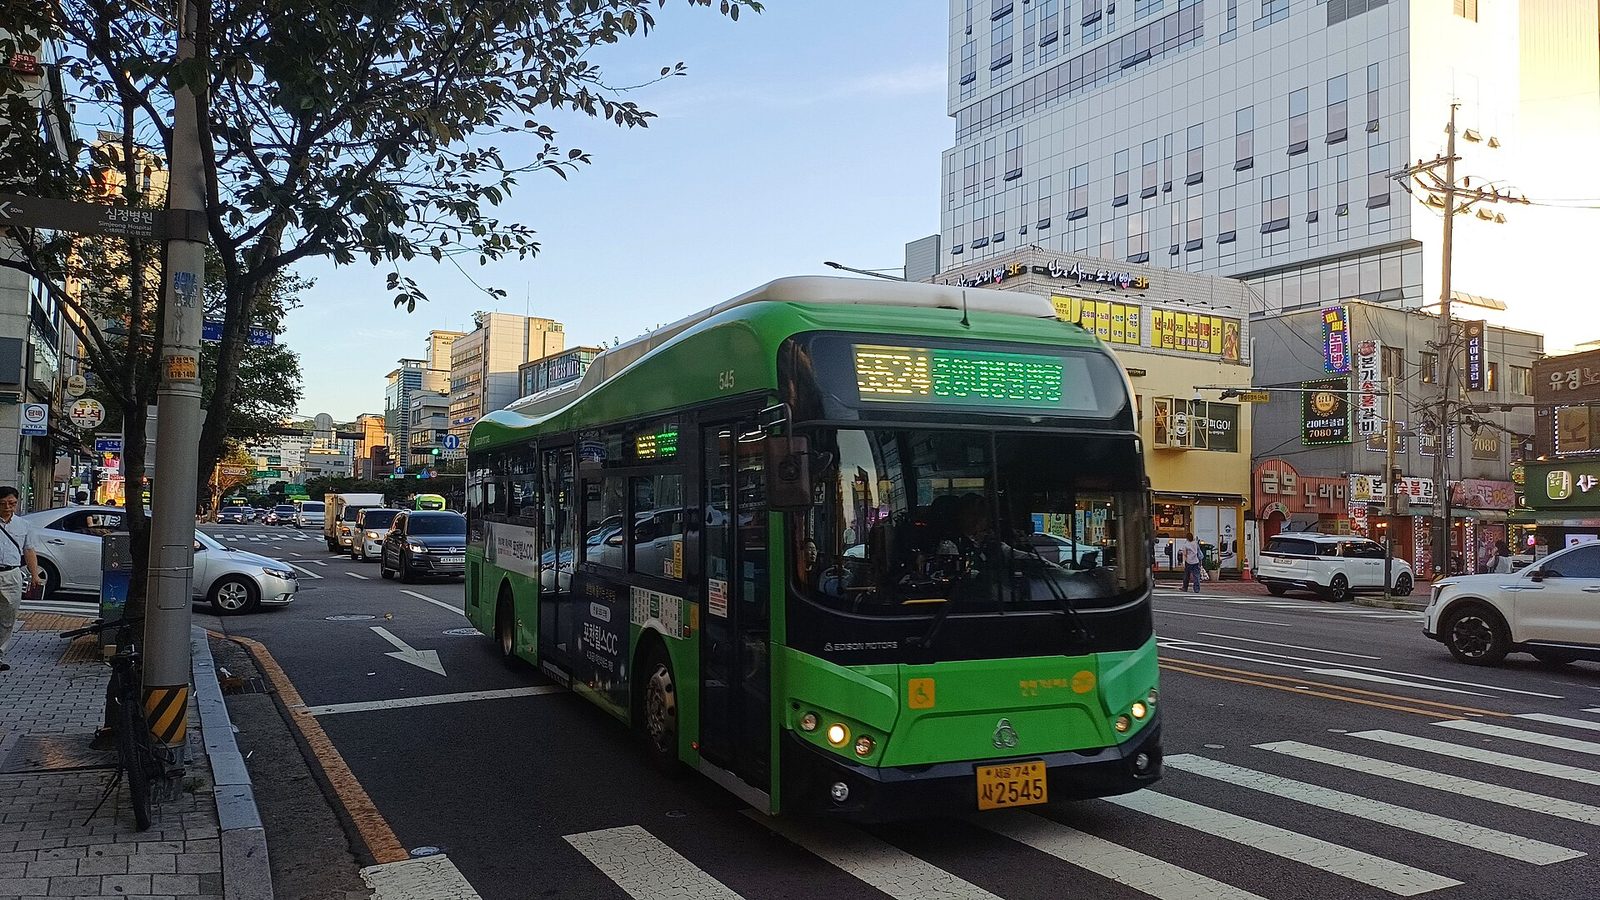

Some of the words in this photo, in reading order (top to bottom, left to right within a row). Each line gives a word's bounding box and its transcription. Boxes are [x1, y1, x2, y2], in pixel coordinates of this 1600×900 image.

[105, 208, 153, 225] 심정병원
[98, 220, 126, 229] Simjeong
[1008, 262, 1021, 276] 3F
[1134, 276, 1149, 288] 3F
[1212, 327, 1221, 336] 3F
[1329, 332, 1344, 369] 노래방
[1469, 337, 1479, 381] 라이브클럽
[719, 371, 735, 391] 545
[27, 409, 42, 417] 담배
[71, 408, 102, 420] 보석
[1306, 418, 1344, 428] 라이브클럽
[1309, 428, 1331, 438] 7080
[1333, 428, 1342, 436] 2F
[1474, 438, 1496, 451] 7080
[583, 622, 618, 656] 포천힐스CC
[834, 642, 864, 651] EDISON
[865, 641, 898, 650] MOTORS
[994, 767, 1011, 778] 서울
[1013, 766, 1030, 777] 74
